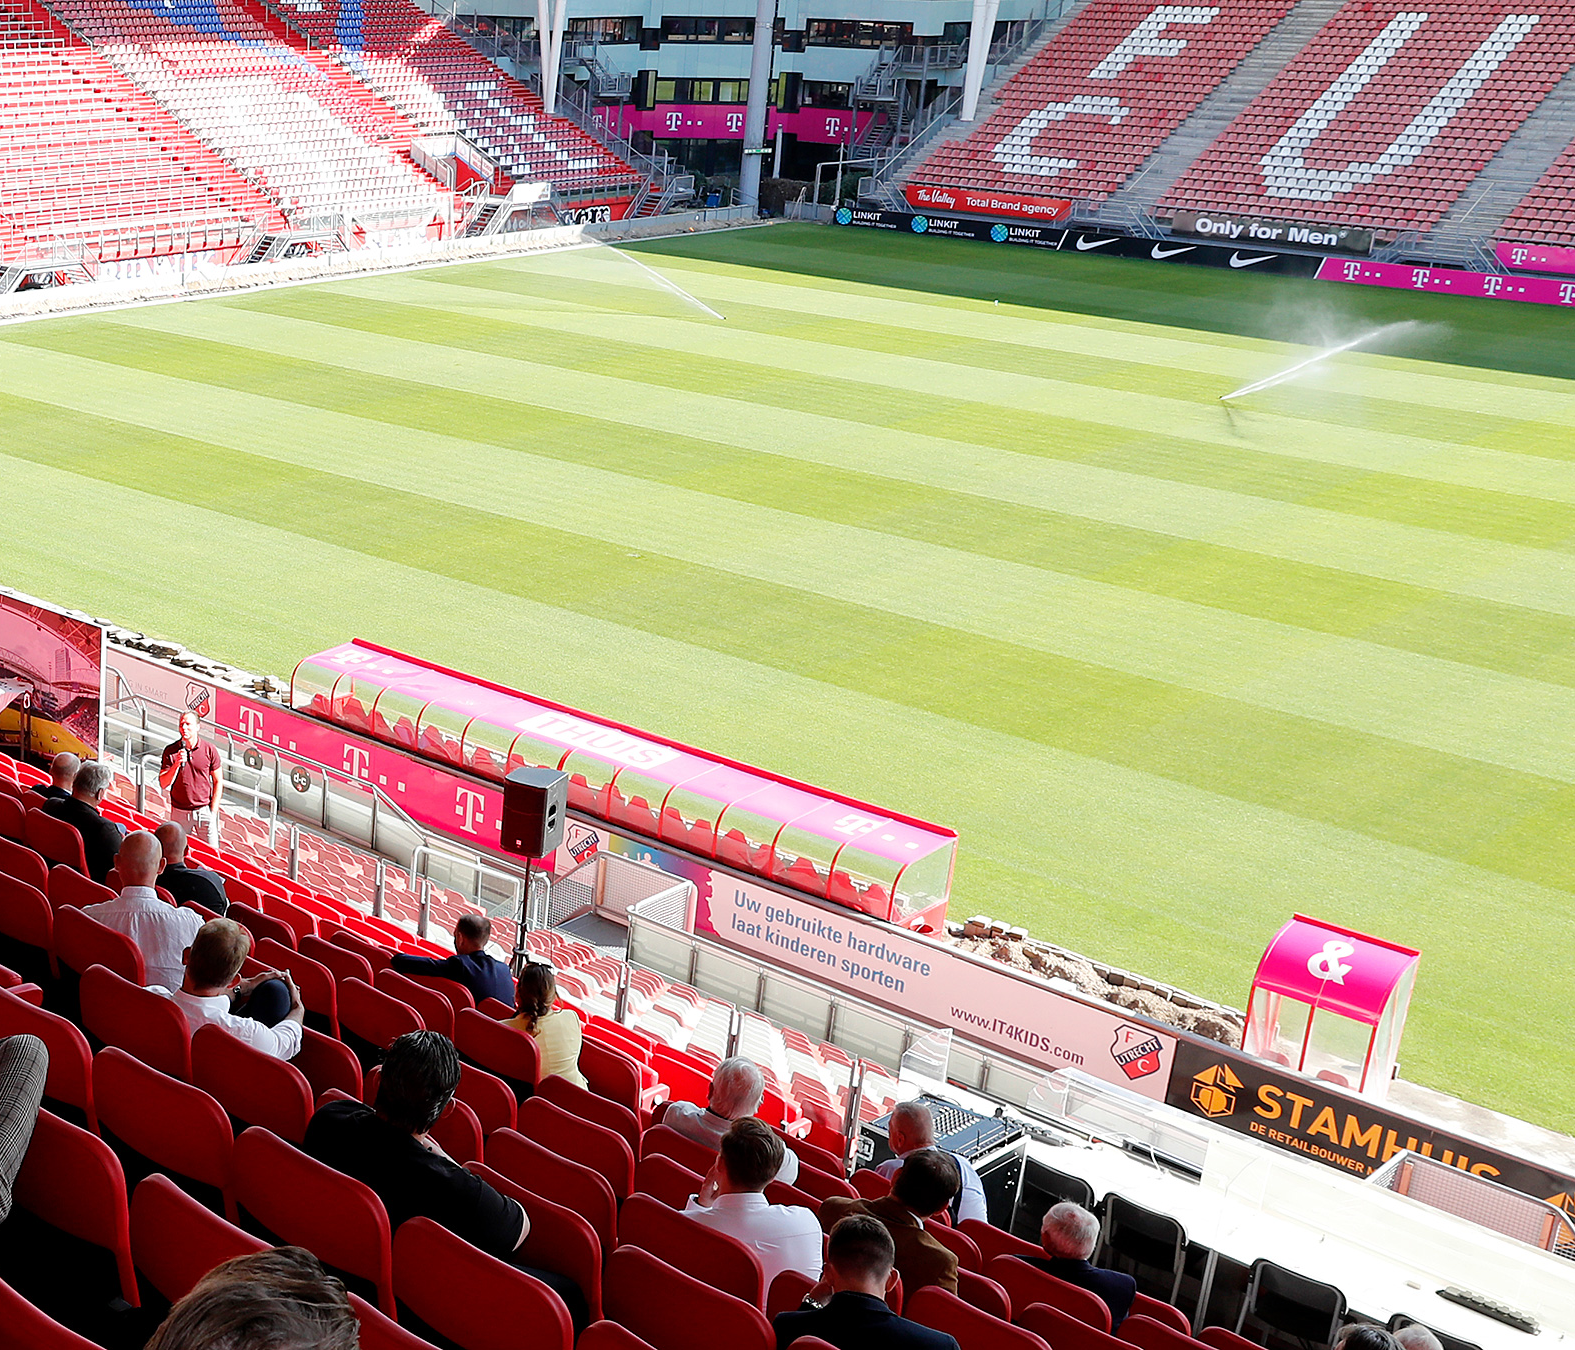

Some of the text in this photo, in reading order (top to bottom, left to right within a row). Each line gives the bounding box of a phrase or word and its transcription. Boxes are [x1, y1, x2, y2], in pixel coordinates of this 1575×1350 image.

[853, 211, 882, 220] LINKIT
[917, 189, 1059, 216] The Valley Total Brand agency
[929, 219, 959, 229] LINKIT
[1010, 227, 1041, 238] LINKIT
[1195, 217, 1244, 239] Only
[1249, 223, 1283, 240] for
[536, 716, 663, 763] THUIS
[734, 889, 931, 978] Uw gebruikte hardware
[731, 912, 905, 994] laat kinderen sporten
[1306, 939, 1355, 985] &
[950, 1005, 1085, 1067] www.IT4KIDS.com
[1115, 1039, 1160, 1066] UTRECHT
[1249, 1121, 1365, 1173] DE RETAILBOUWER
